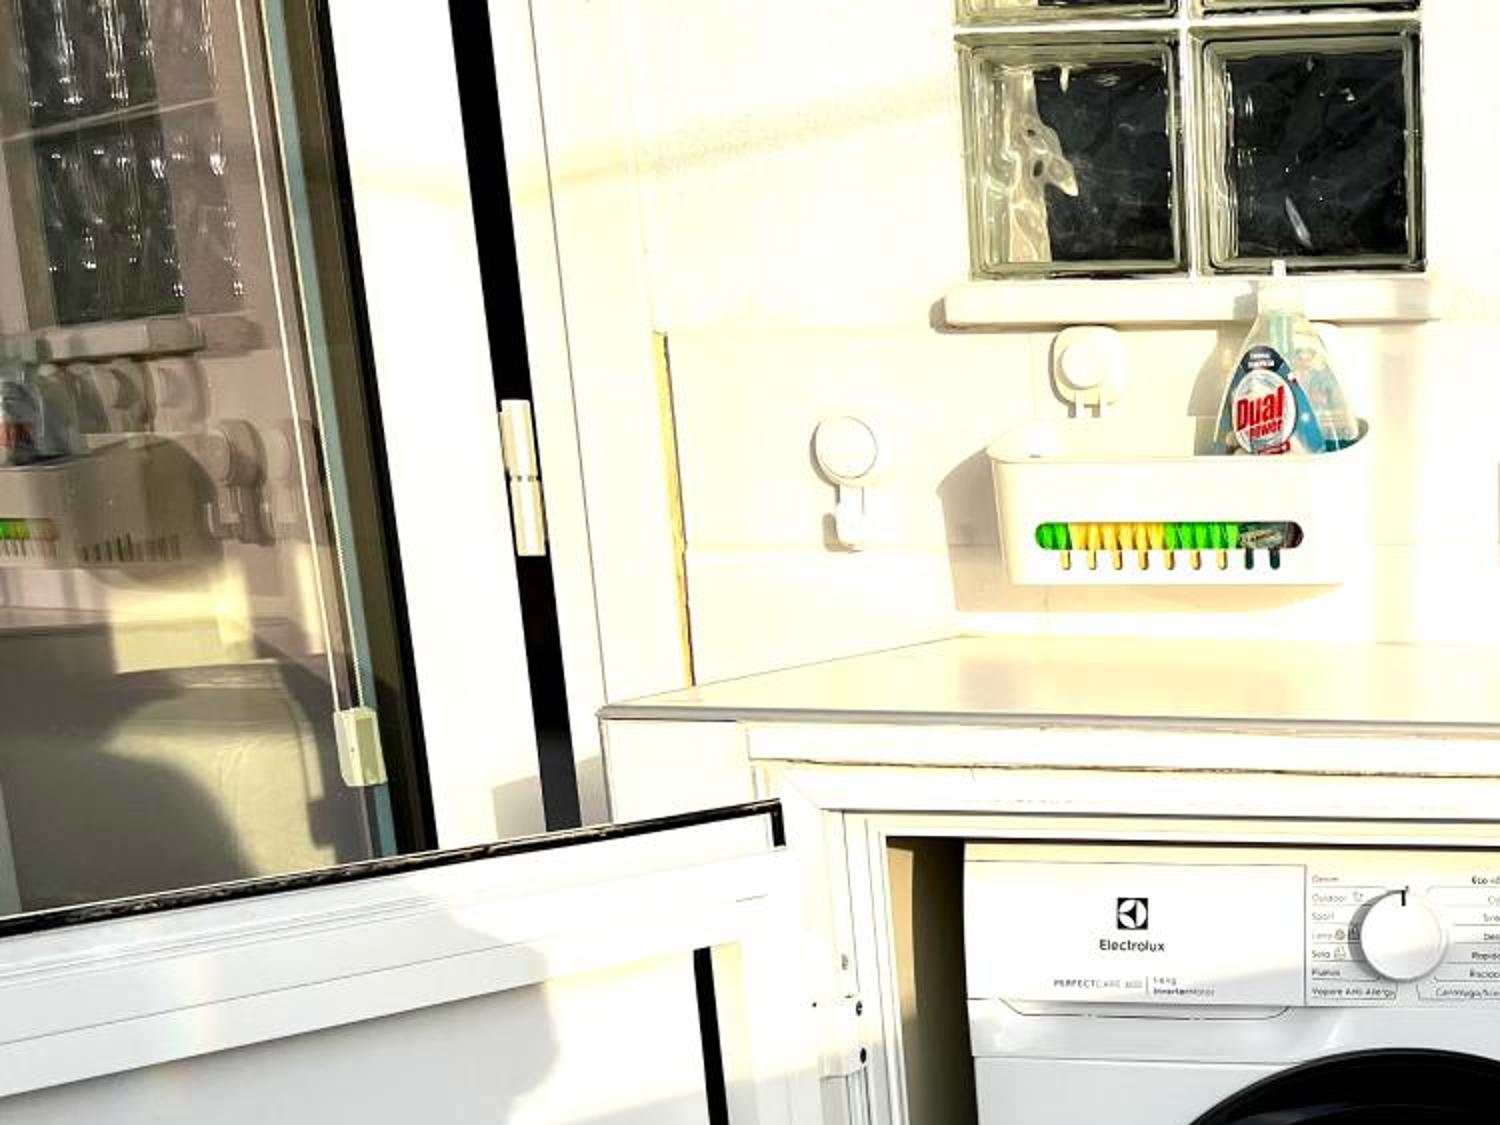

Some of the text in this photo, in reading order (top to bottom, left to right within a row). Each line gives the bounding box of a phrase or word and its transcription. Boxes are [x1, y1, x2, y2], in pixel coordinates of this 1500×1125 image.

[1236, 385, 1284, 432] Dual
[1471, 876, 1487, 885] Eco
[1099, 938, 1166, 953] Electrolux
